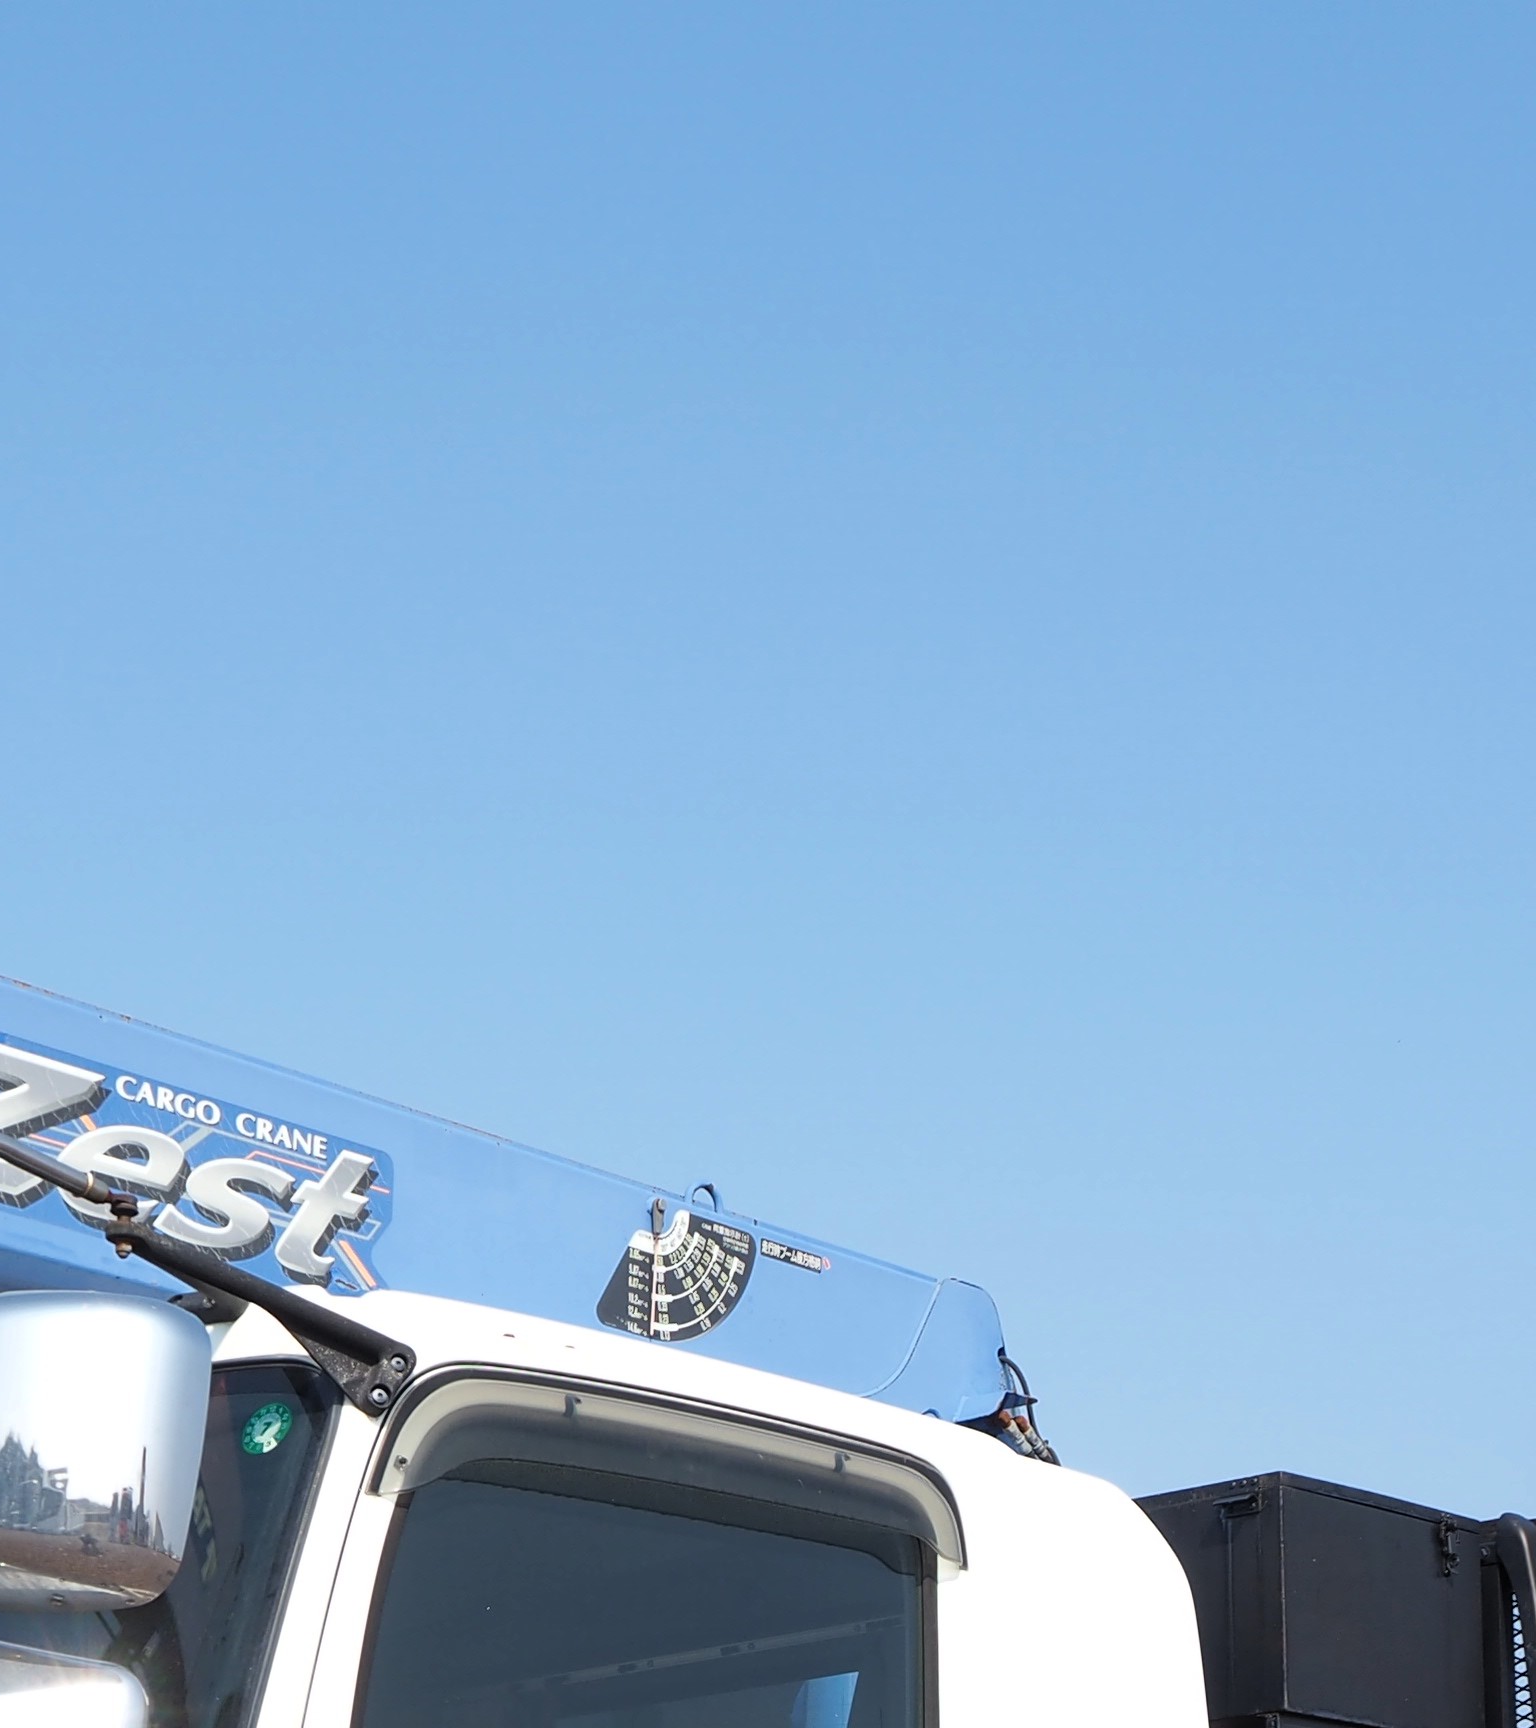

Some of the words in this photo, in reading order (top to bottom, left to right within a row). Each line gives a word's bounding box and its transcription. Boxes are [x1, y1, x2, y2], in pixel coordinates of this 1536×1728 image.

[115, 1075, 221, 1125] CARGO
[235, 1112, 328, 1160] CRANE
[255, 1421, 273, 1437] 7
